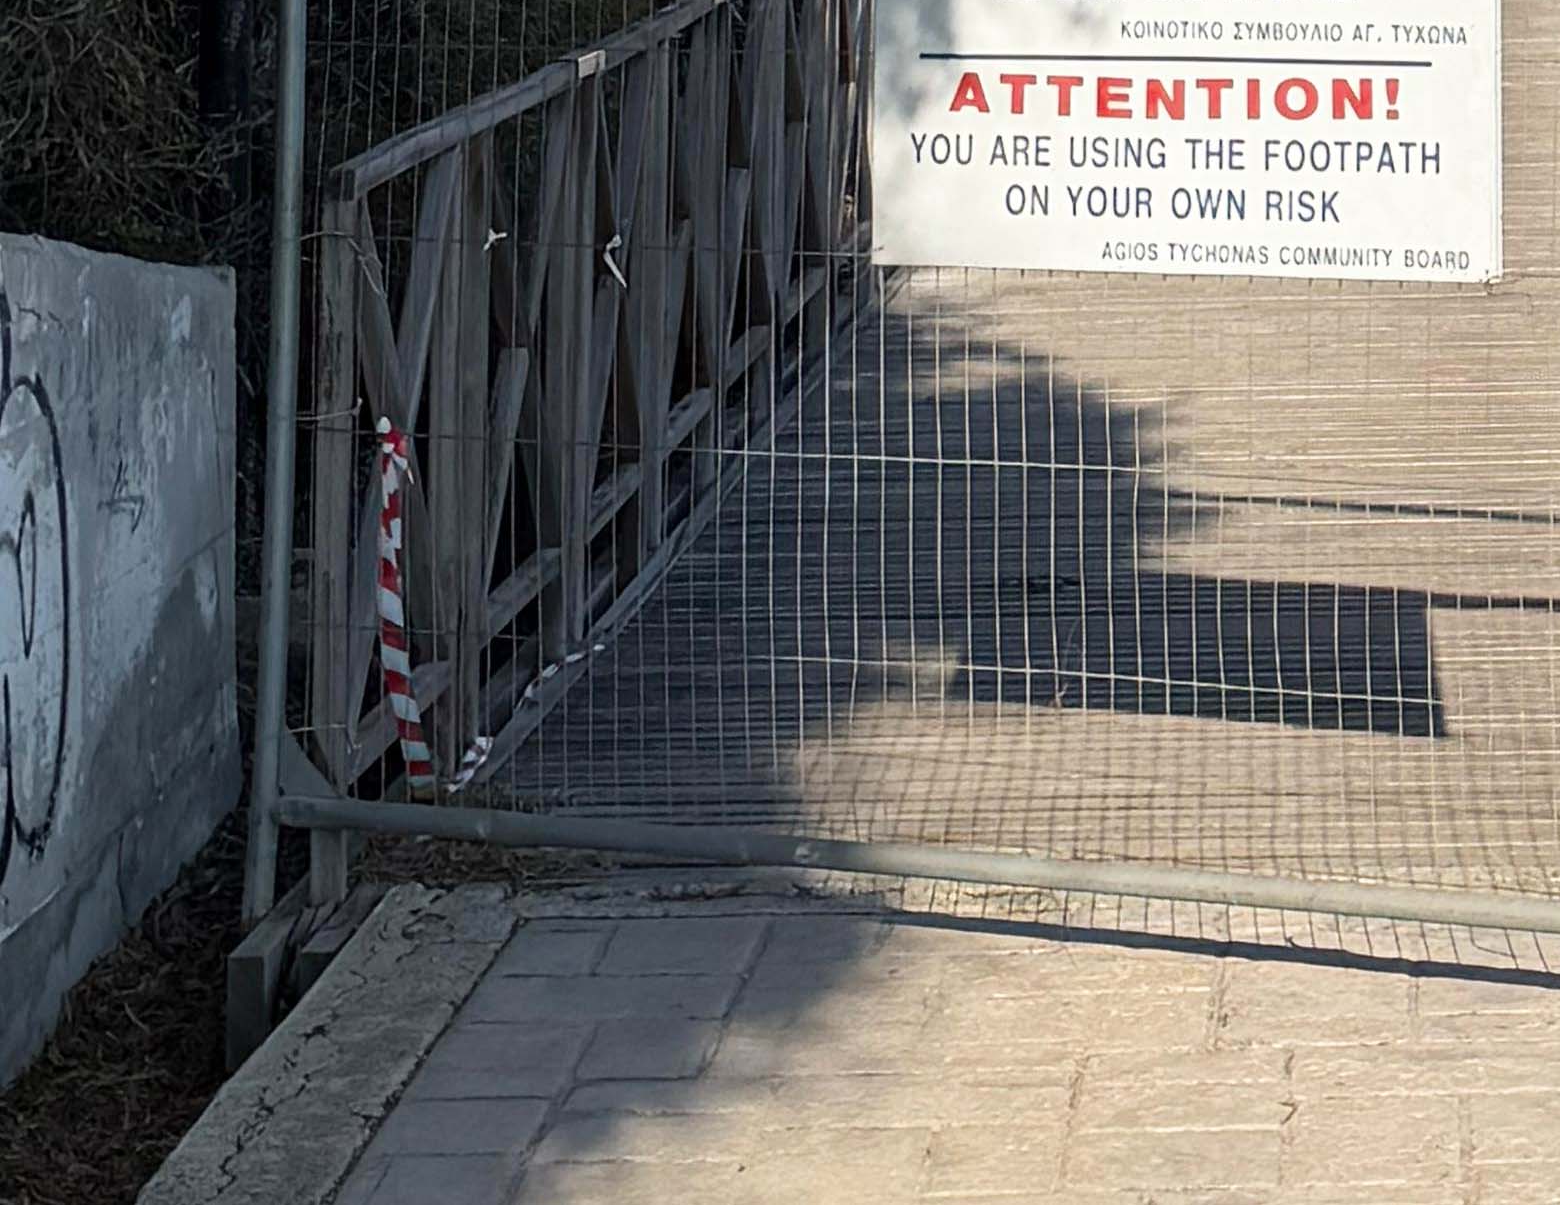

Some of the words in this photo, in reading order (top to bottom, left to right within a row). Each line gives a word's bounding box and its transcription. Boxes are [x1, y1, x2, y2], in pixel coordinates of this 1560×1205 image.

[1121, 20, 1223, 41] ΚΟΙΝΟΤΙΚΟ
[1233, 21, 1343, 43] ΣΥΜΒΟΥΛΙΟ
[1351, 23, 1382, 43] ΑΓ.
[1391, 24, 1468, 45] ΤΥΧΩΝΑ
[948, 71, 1400, 121] ATTENTION!
[910, 132, 974, 166] YOU
[988, 134, 1052, 168] ARE
[1069, 135, 1167, 170] USING
[1183, 138, 1246, 171] THE
[1264, 139, 1441, 175] FOOTPATH
[1005, 183, 1049, 217] ON
[1066, 185, 1153, 219] YOUR
[1171, 187, 1246, 222] OWN
[1265, 189, 1341, 224] RISK
[1101, 241, 1159, 262] AGIOS
[1167, 242, 1269, 265] TYCHONAS
[1279, 245, 1393, 267] COMMUNITY
[1404, 248, 1470, 270] BOARD
